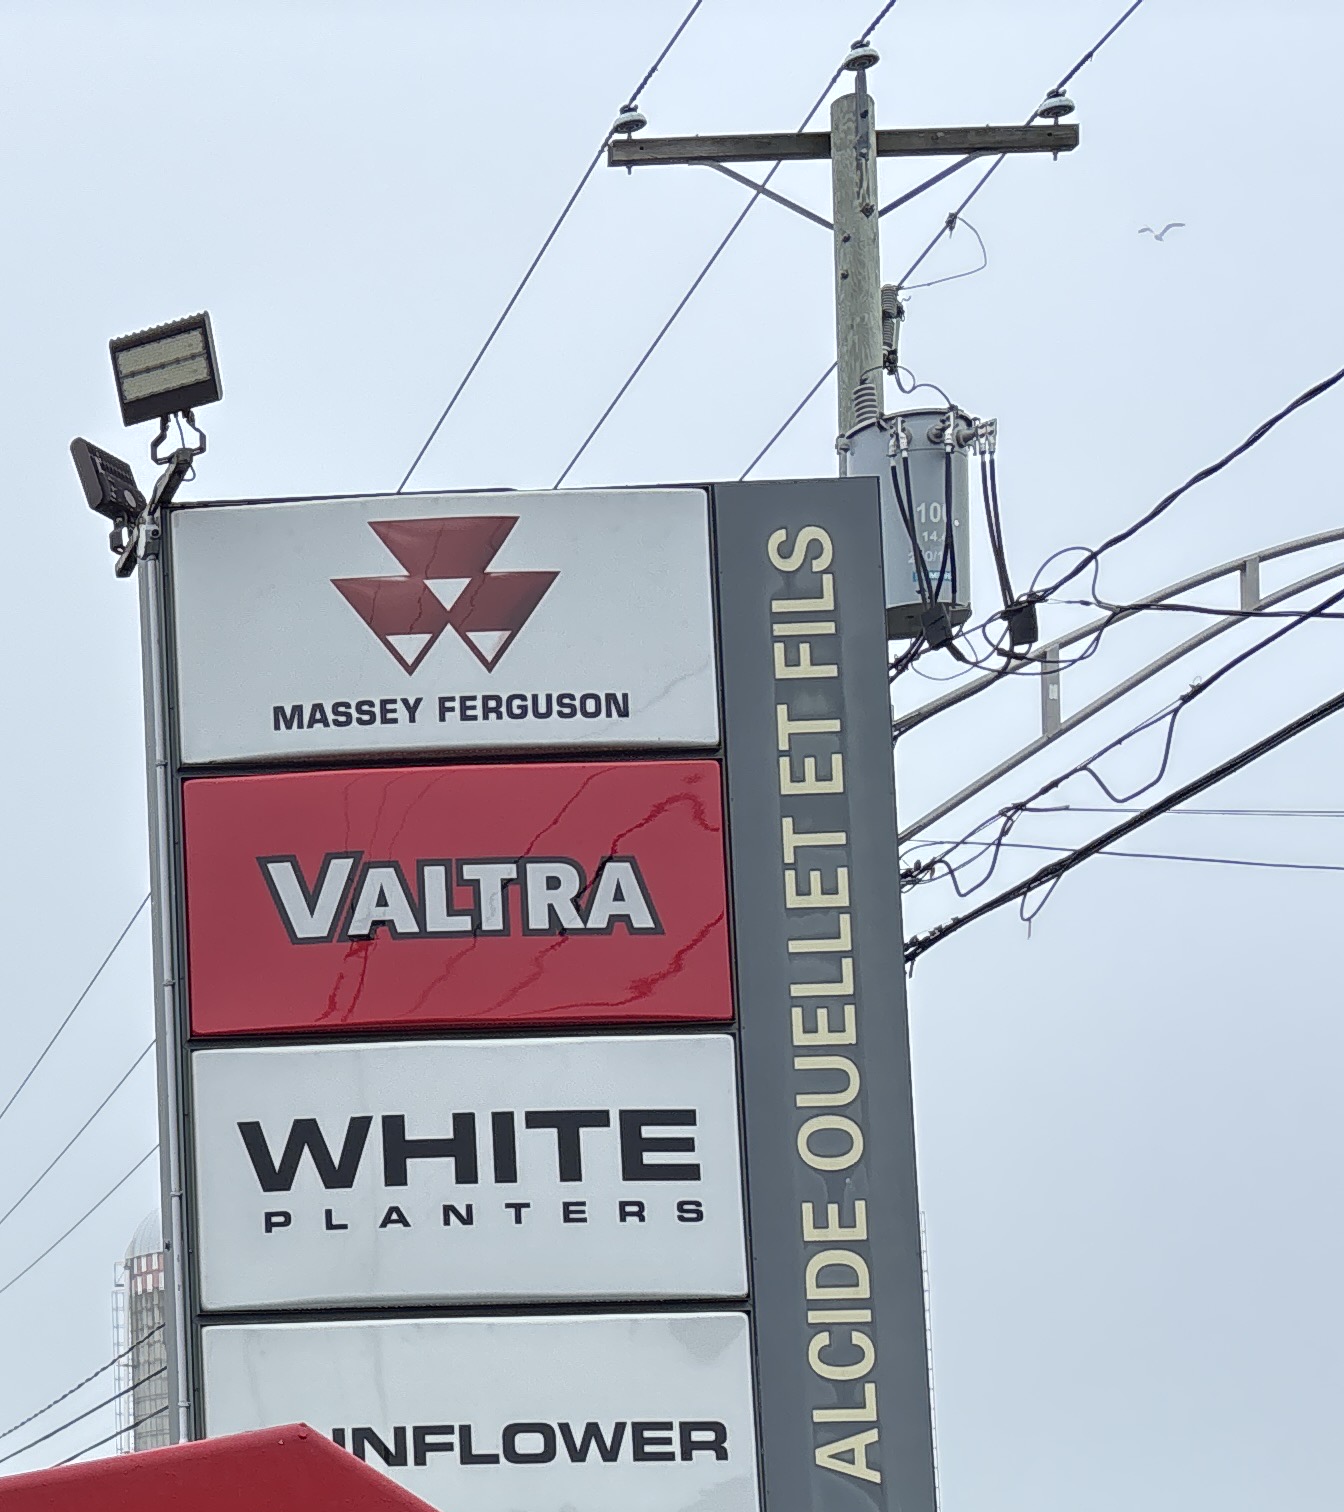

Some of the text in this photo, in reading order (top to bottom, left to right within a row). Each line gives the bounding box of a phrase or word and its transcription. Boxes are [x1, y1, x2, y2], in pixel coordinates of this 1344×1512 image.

[272, 691, 631, 732] MASSEY FERGUSON
[255, 850, 666, 945] VALTRA
[767, 524, 882, 1484] ALCIDE OUELLET ET FILS
[236, 1108, 702, 1193] WHITE
[263, 1199, 705, 1234] PLANTERS
[332, 1420, 729, 1467] NFLOWER
